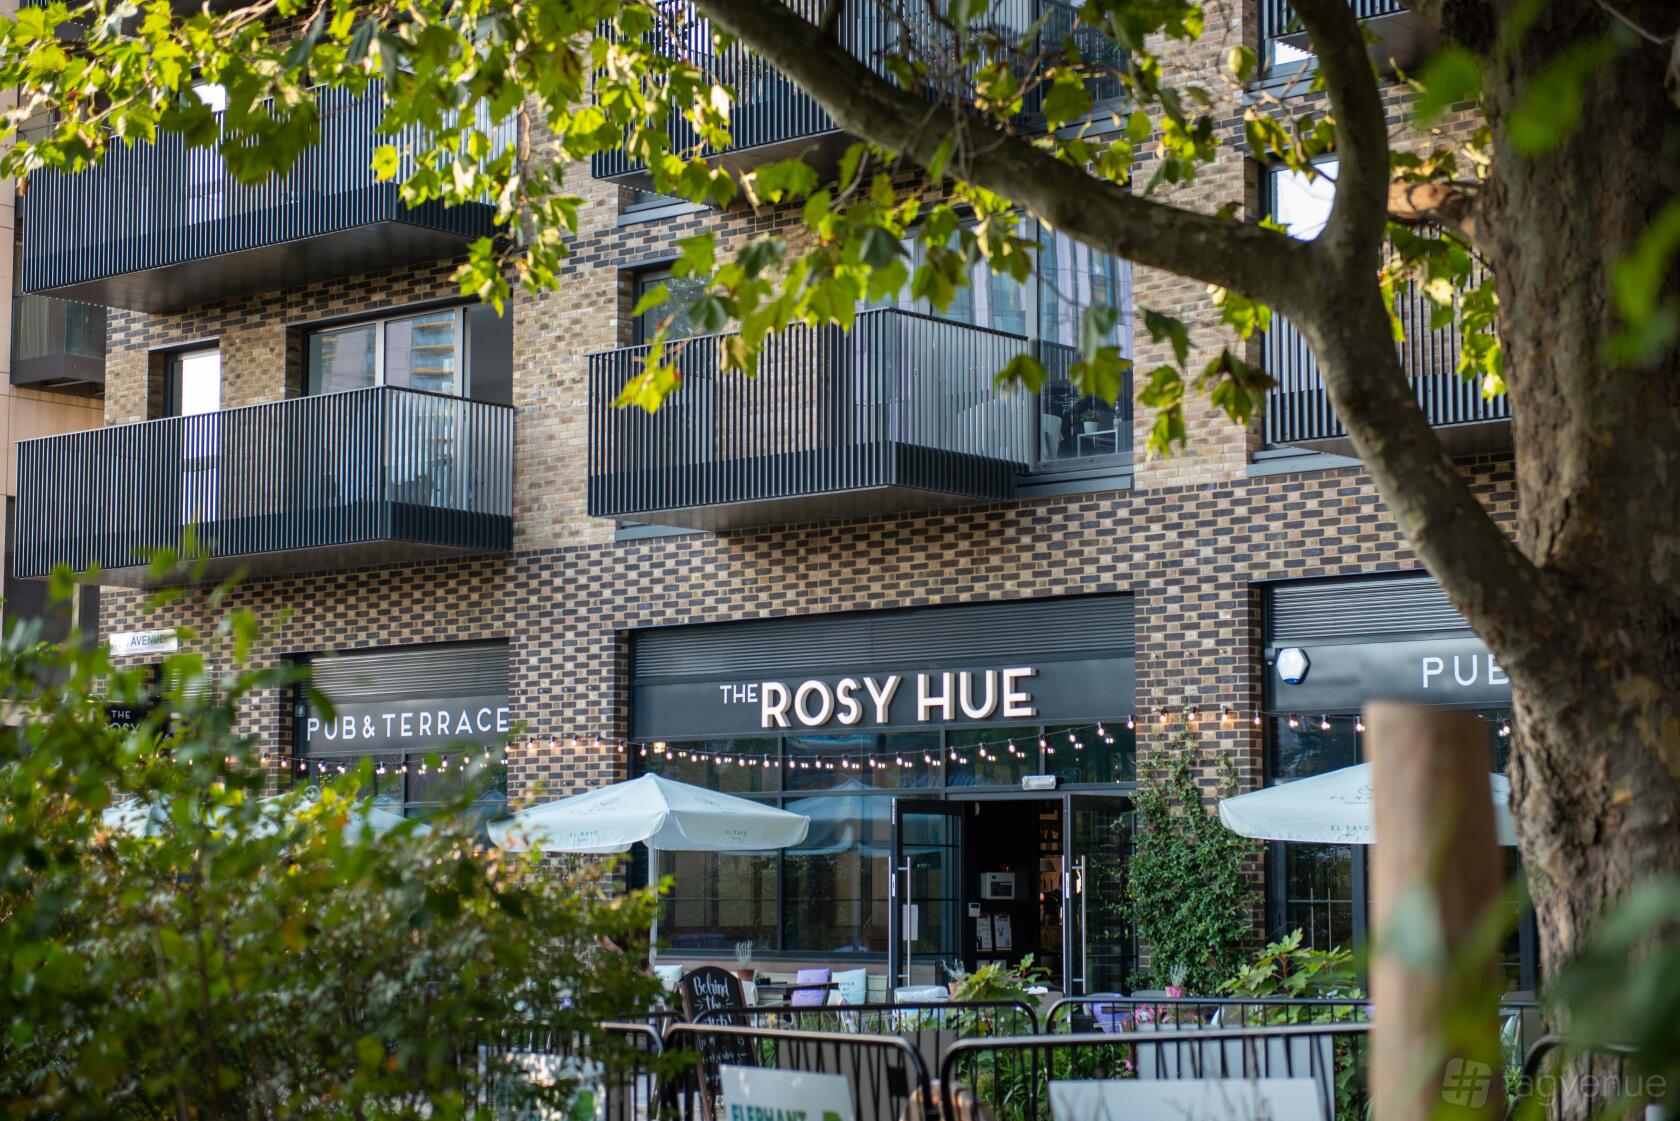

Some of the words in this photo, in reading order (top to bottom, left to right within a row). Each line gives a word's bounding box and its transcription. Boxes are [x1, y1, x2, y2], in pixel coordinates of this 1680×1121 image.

[719, 684, 758, 704] THE
[761, 675, 902, 728] ROSY
[917, 667, 1037, 721] HUE
[111, 710, 131, 719] THE
[307, 715, 356, 741] PUB
[382, 708, 510, 737] TERRACE
[693, 972, 729, 997] Behind
